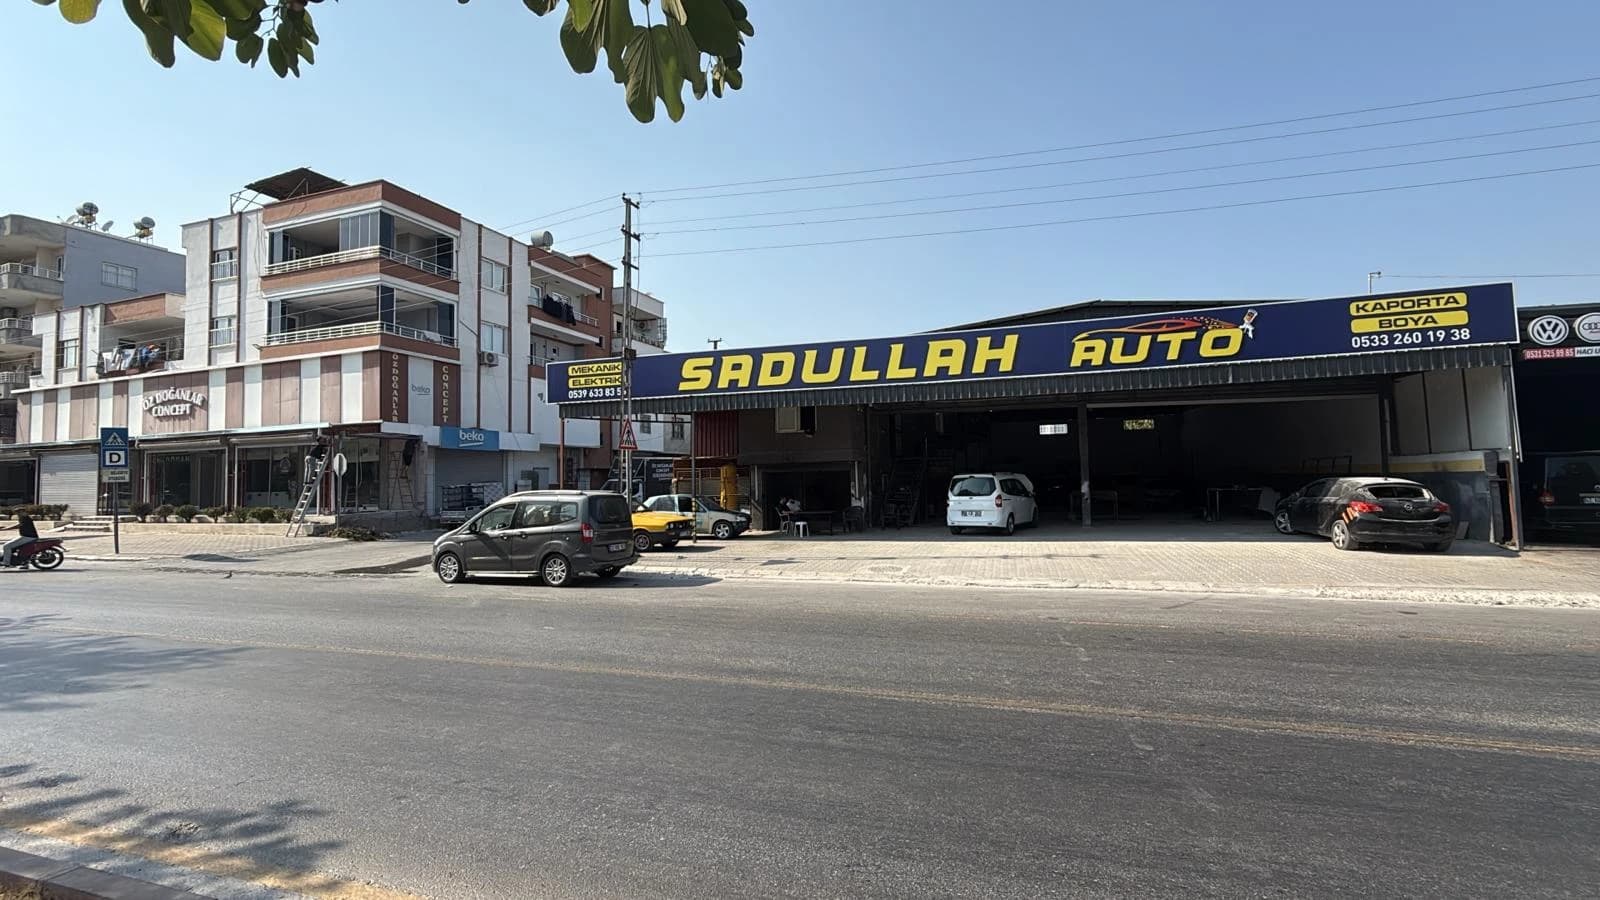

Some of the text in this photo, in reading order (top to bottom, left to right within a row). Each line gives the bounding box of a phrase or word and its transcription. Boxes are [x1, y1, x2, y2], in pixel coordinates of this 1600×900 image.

[1355, 296, 1460, 313] KAPORTA
[1378, 315, 1438, 329] BOYA
[1351, 328, 1471, 348] 0533 260 19 38
[1070, 328, 1243, 367] AUTO
[678, 334, 1019, 391] SADULLAH
[411, 384, 431, 393] beko
[568, 390, 587, 399] 0539
[589, 388, 603, 398] 633
[605, 387, 615, 397] 83
[156, 386, 203, 406] DOĞANLAR
[152, 403, 192, 417] CONCEPT
[459, 430, 485, 441] beko
[109, 452, 121, 464] D
